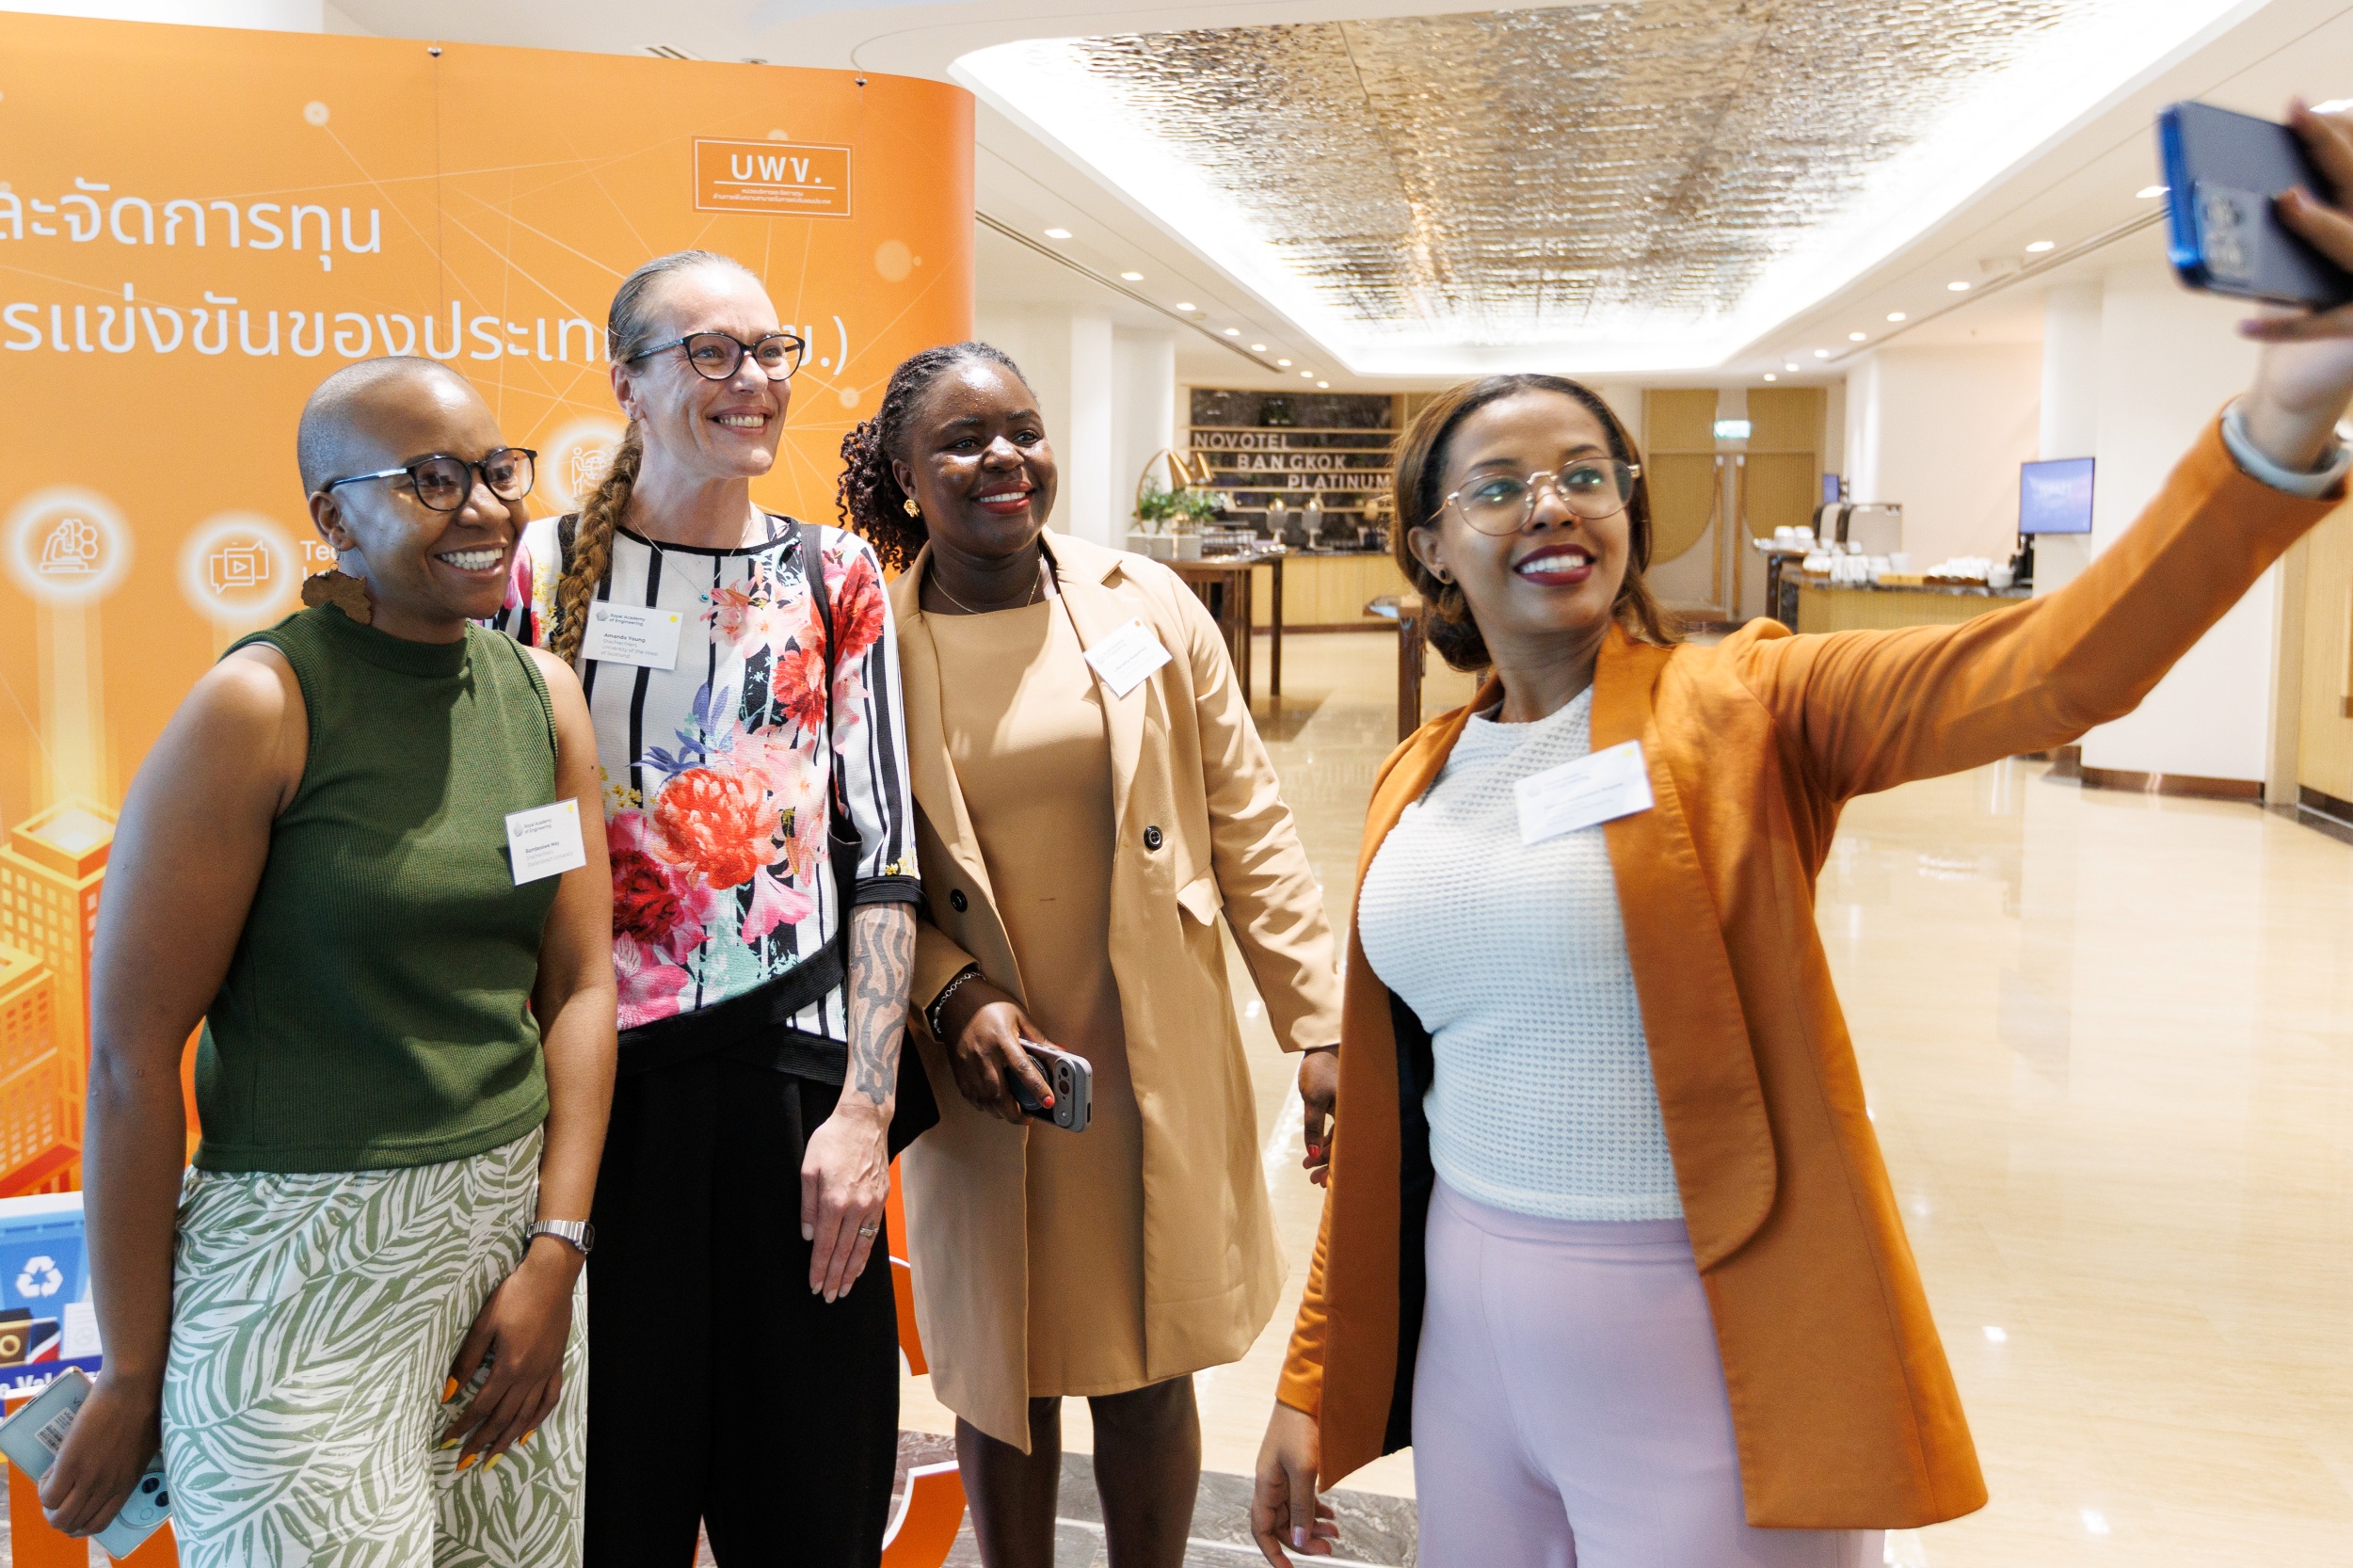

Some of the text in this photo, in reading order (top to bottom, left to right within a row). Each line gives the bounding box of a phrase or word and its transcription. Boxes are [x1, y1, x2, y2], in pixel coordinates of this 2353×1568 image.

[731, 153, 822, 184] บพข.
[3, 283, 611, 363] รแข่งขันของประเท
[1193, 433, 1289, 449] NOVOTEL
[1237, 454, 1346, 470] BANGKOK
[1288, 474, 1391, 489] PLATINUM
